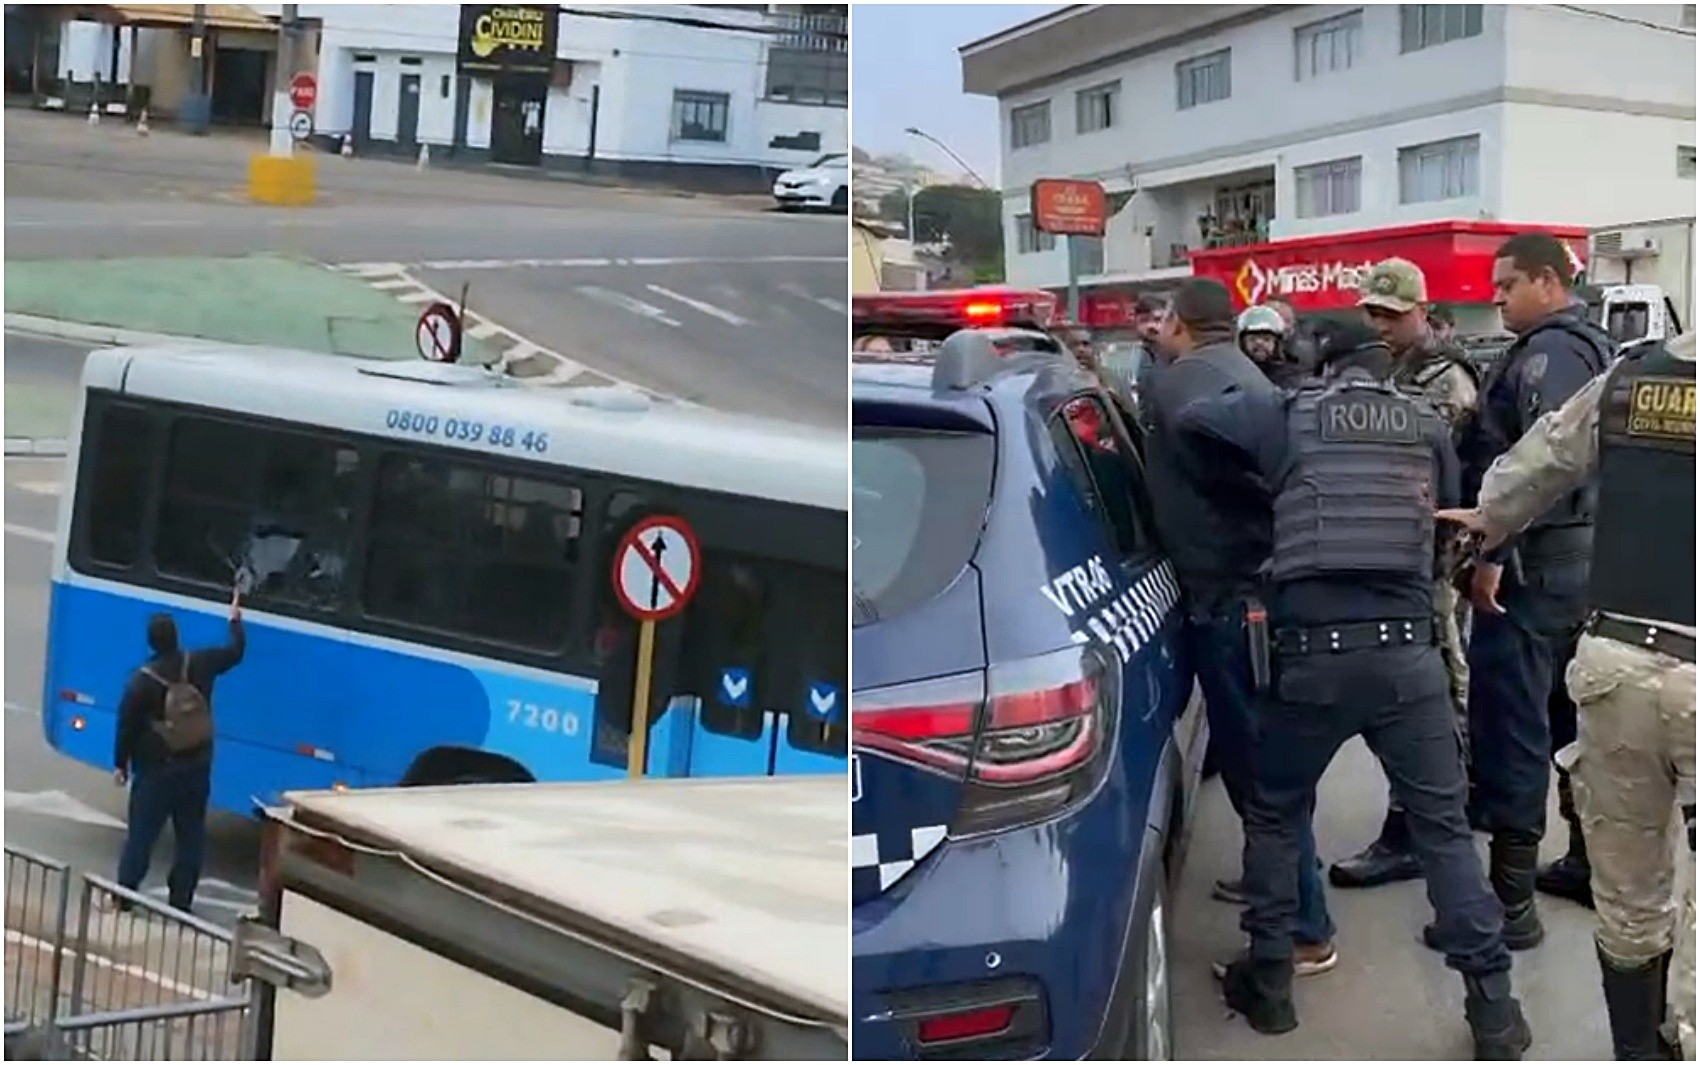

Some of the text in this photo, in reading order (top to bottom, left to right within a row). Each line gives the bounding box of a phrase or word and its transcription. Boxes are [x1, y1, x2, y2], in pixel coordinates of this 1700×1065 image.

[476, 15, 544, 39] CIVIDINI
[1266, 265, 1320, 295] Minas
[386, 409, 548, 452] 0800 039 88 46
[1329, 403, 1407, 432] ROMO
[507, 700, 578, 736] 7200
